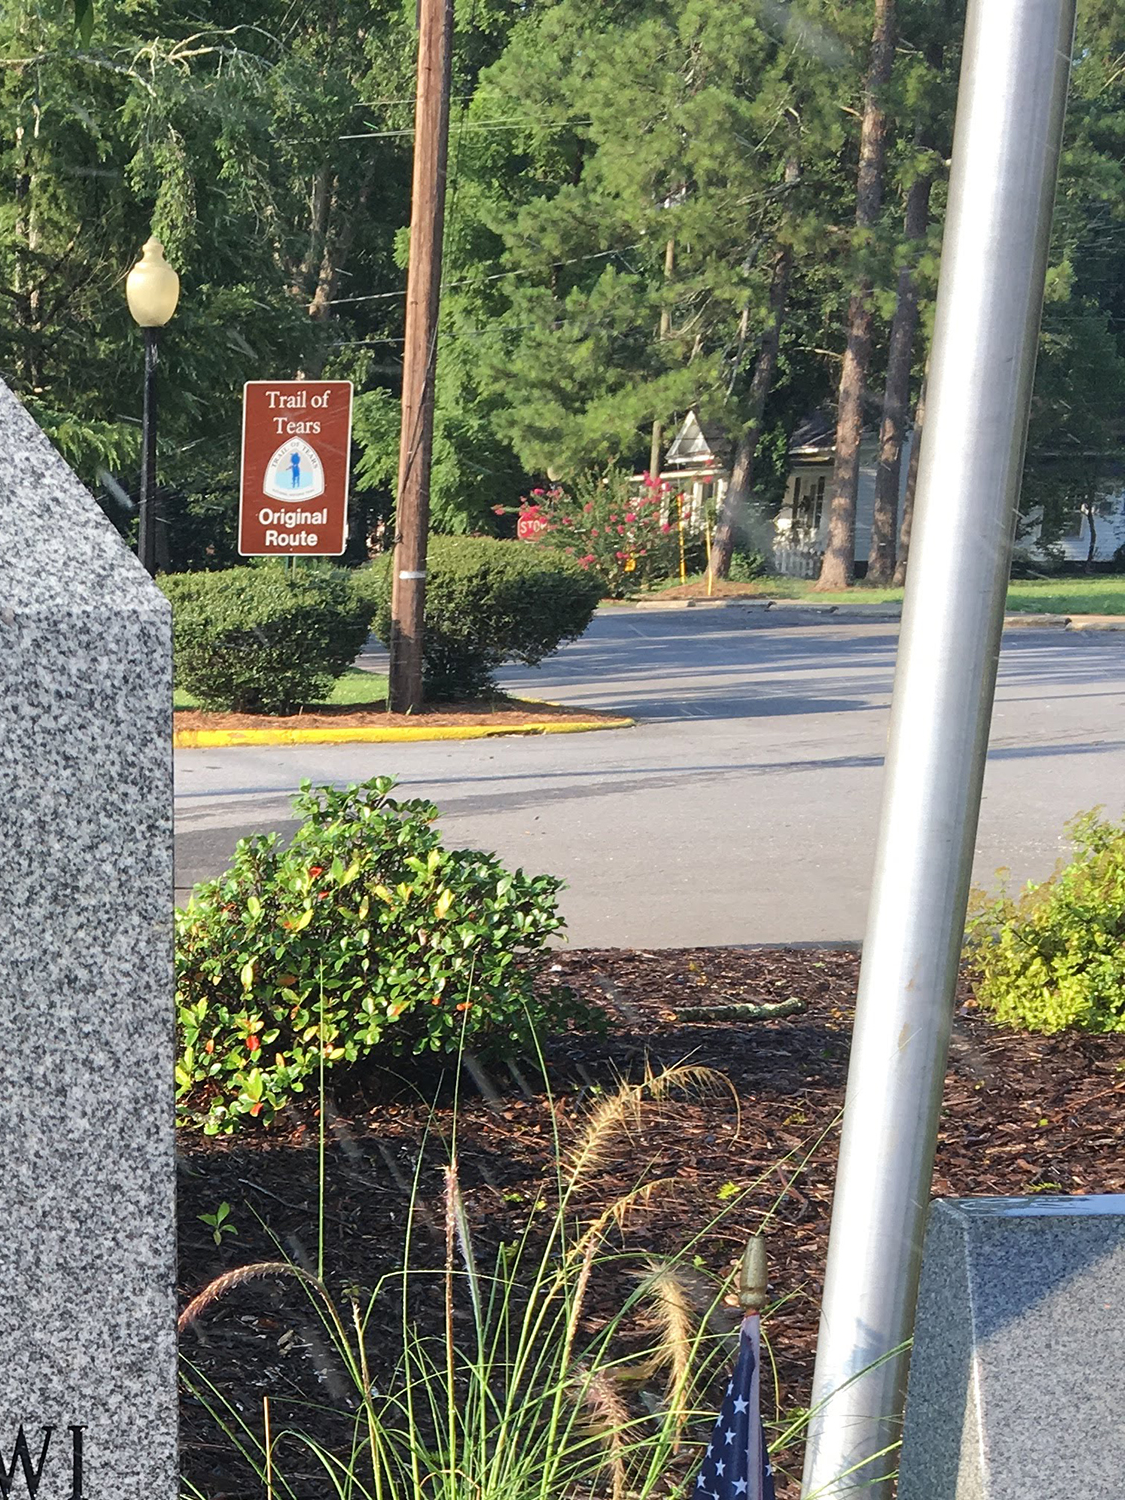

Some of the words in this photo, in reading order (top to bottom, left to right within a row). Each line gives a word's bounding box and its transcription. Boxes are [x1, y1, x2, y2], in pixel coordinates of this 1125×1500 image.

[266, 391, 306, 408] Trail
[310, 390, 330, 408] of
[273, 417, 321, 434] Tears
[259, 508, 327, 528] Original
[265, 530, 318, 546] Route
